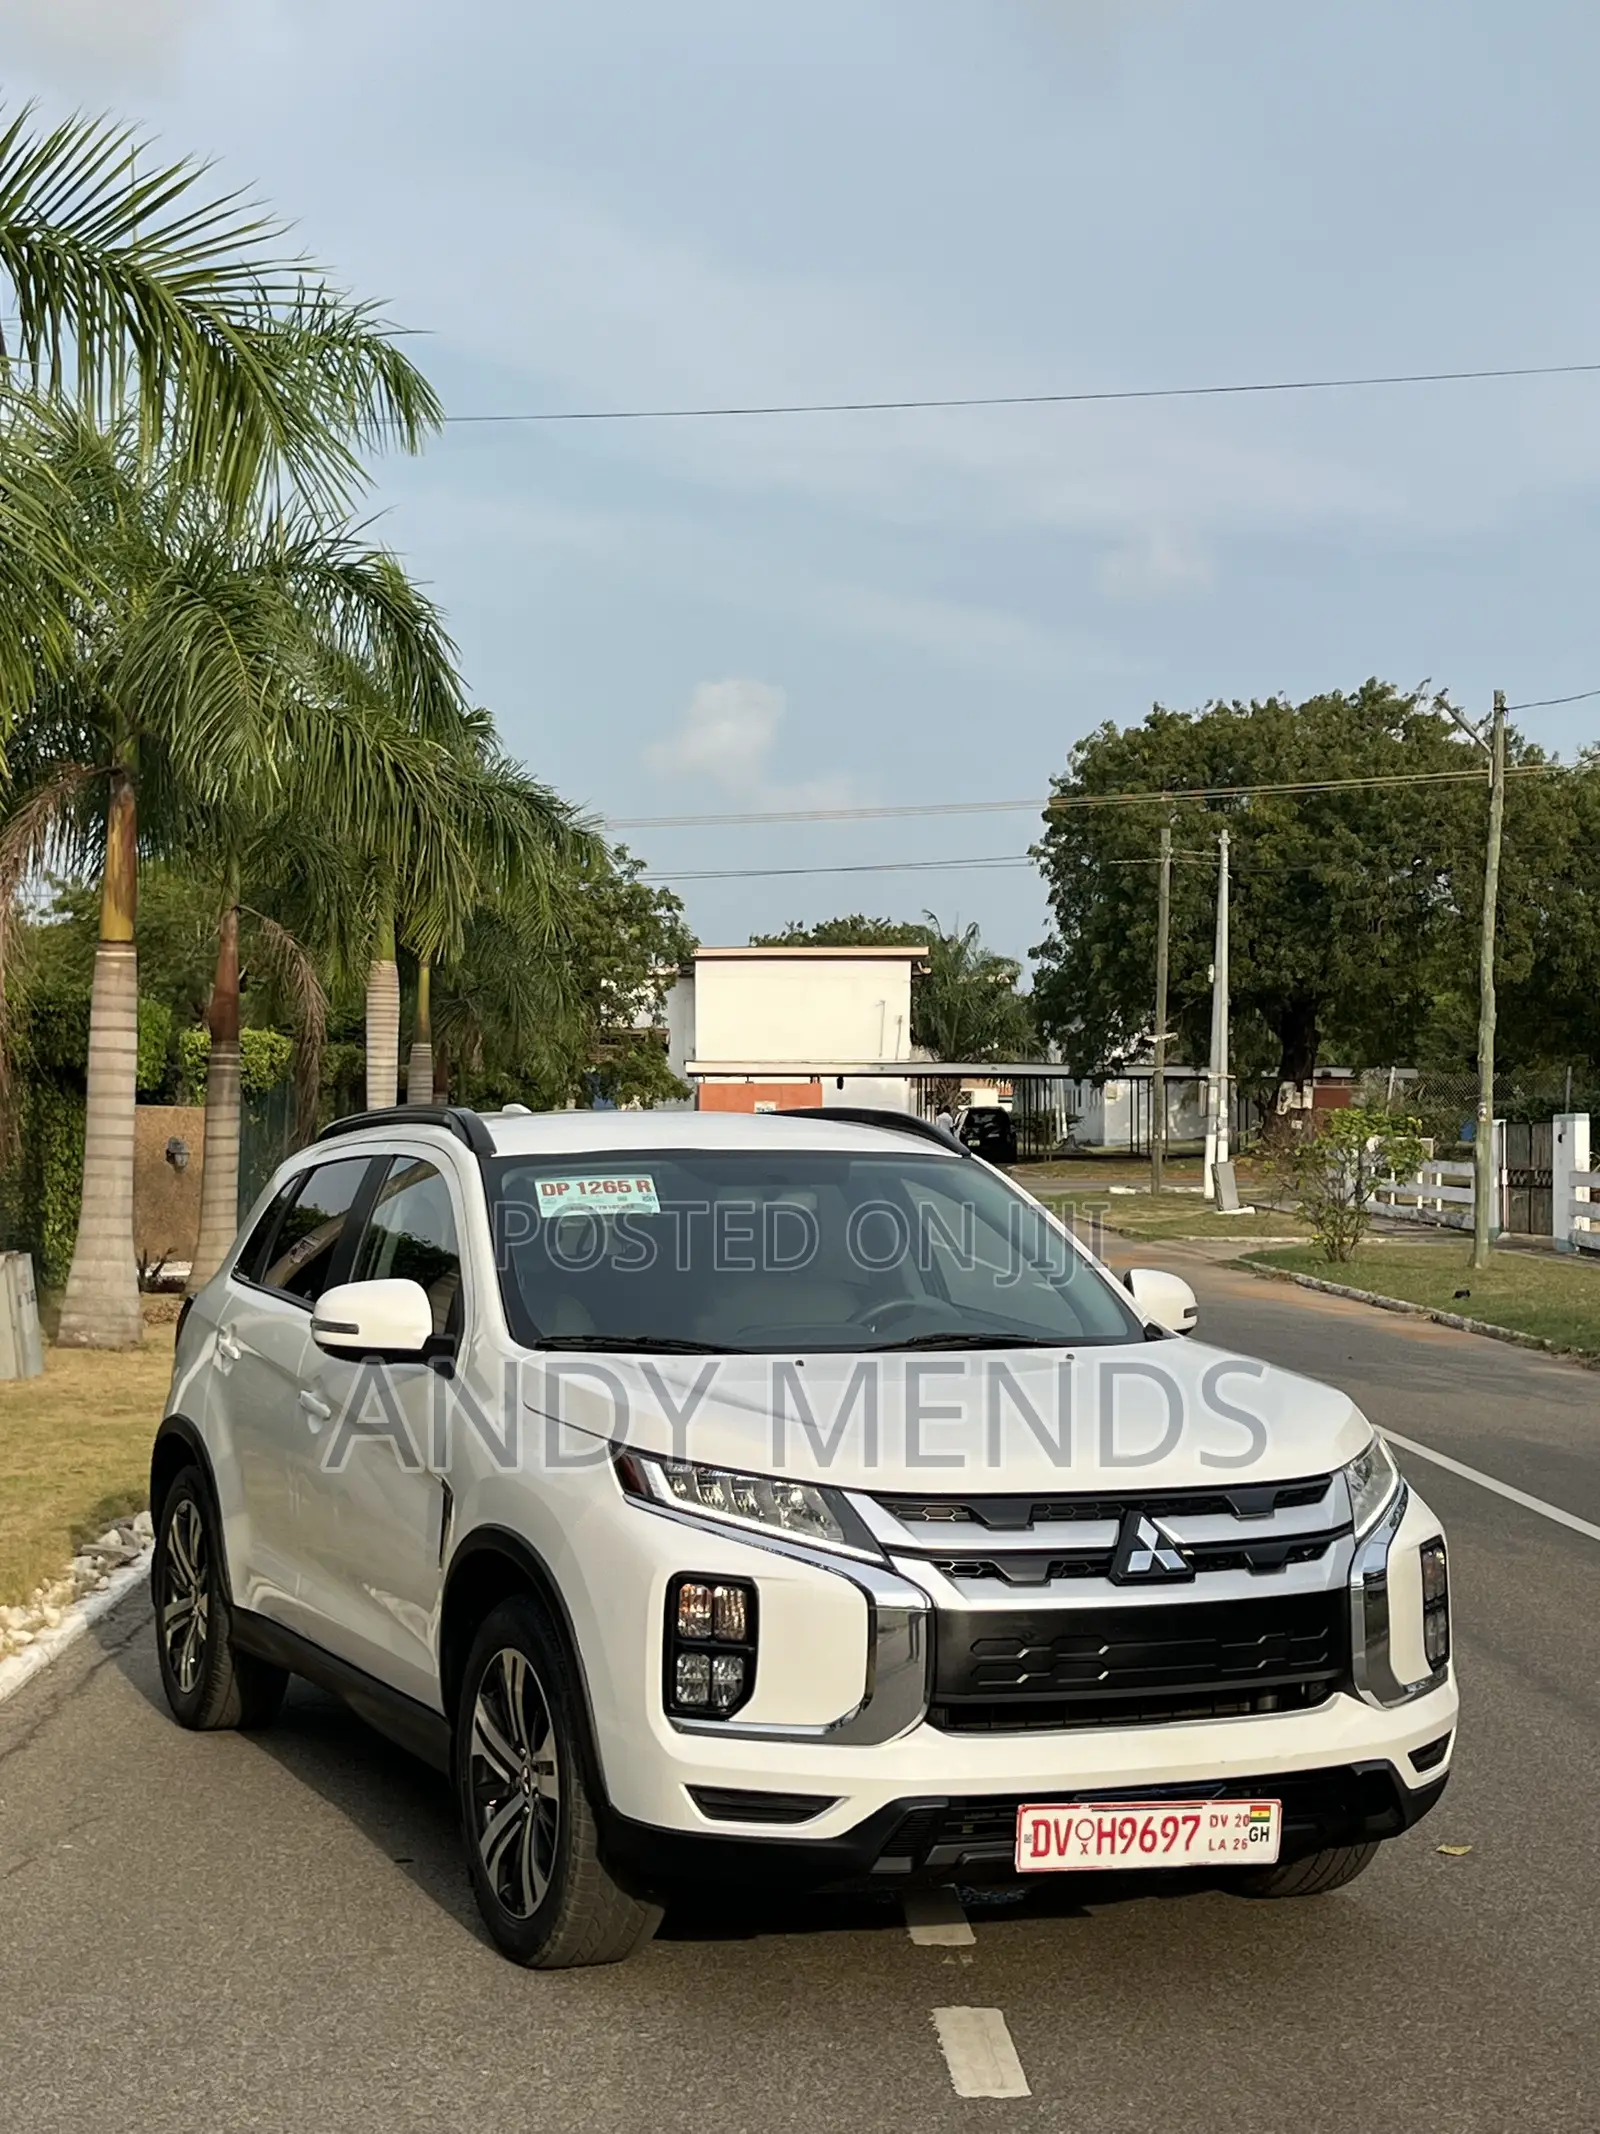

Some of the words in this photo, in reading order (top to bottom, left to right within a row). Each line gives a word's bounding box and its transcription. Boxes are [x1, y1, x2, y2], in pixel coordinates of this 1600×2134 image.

[541, 1182, 570, 1196] DP
[576, 1180, 632, 1195] 1265
[636, 1180, 652, 1193] R
[1209, 1814, 1229, 1829] DV
[1234, 1813, 1251, 1828] 20
[1030, 1818, 1073, 1857] DV
[1096, 1814, 1201, 1855] H9697
[1248, 1825, 1271, 1843] GH
[1208, 1839, 1227, 1852] LA
